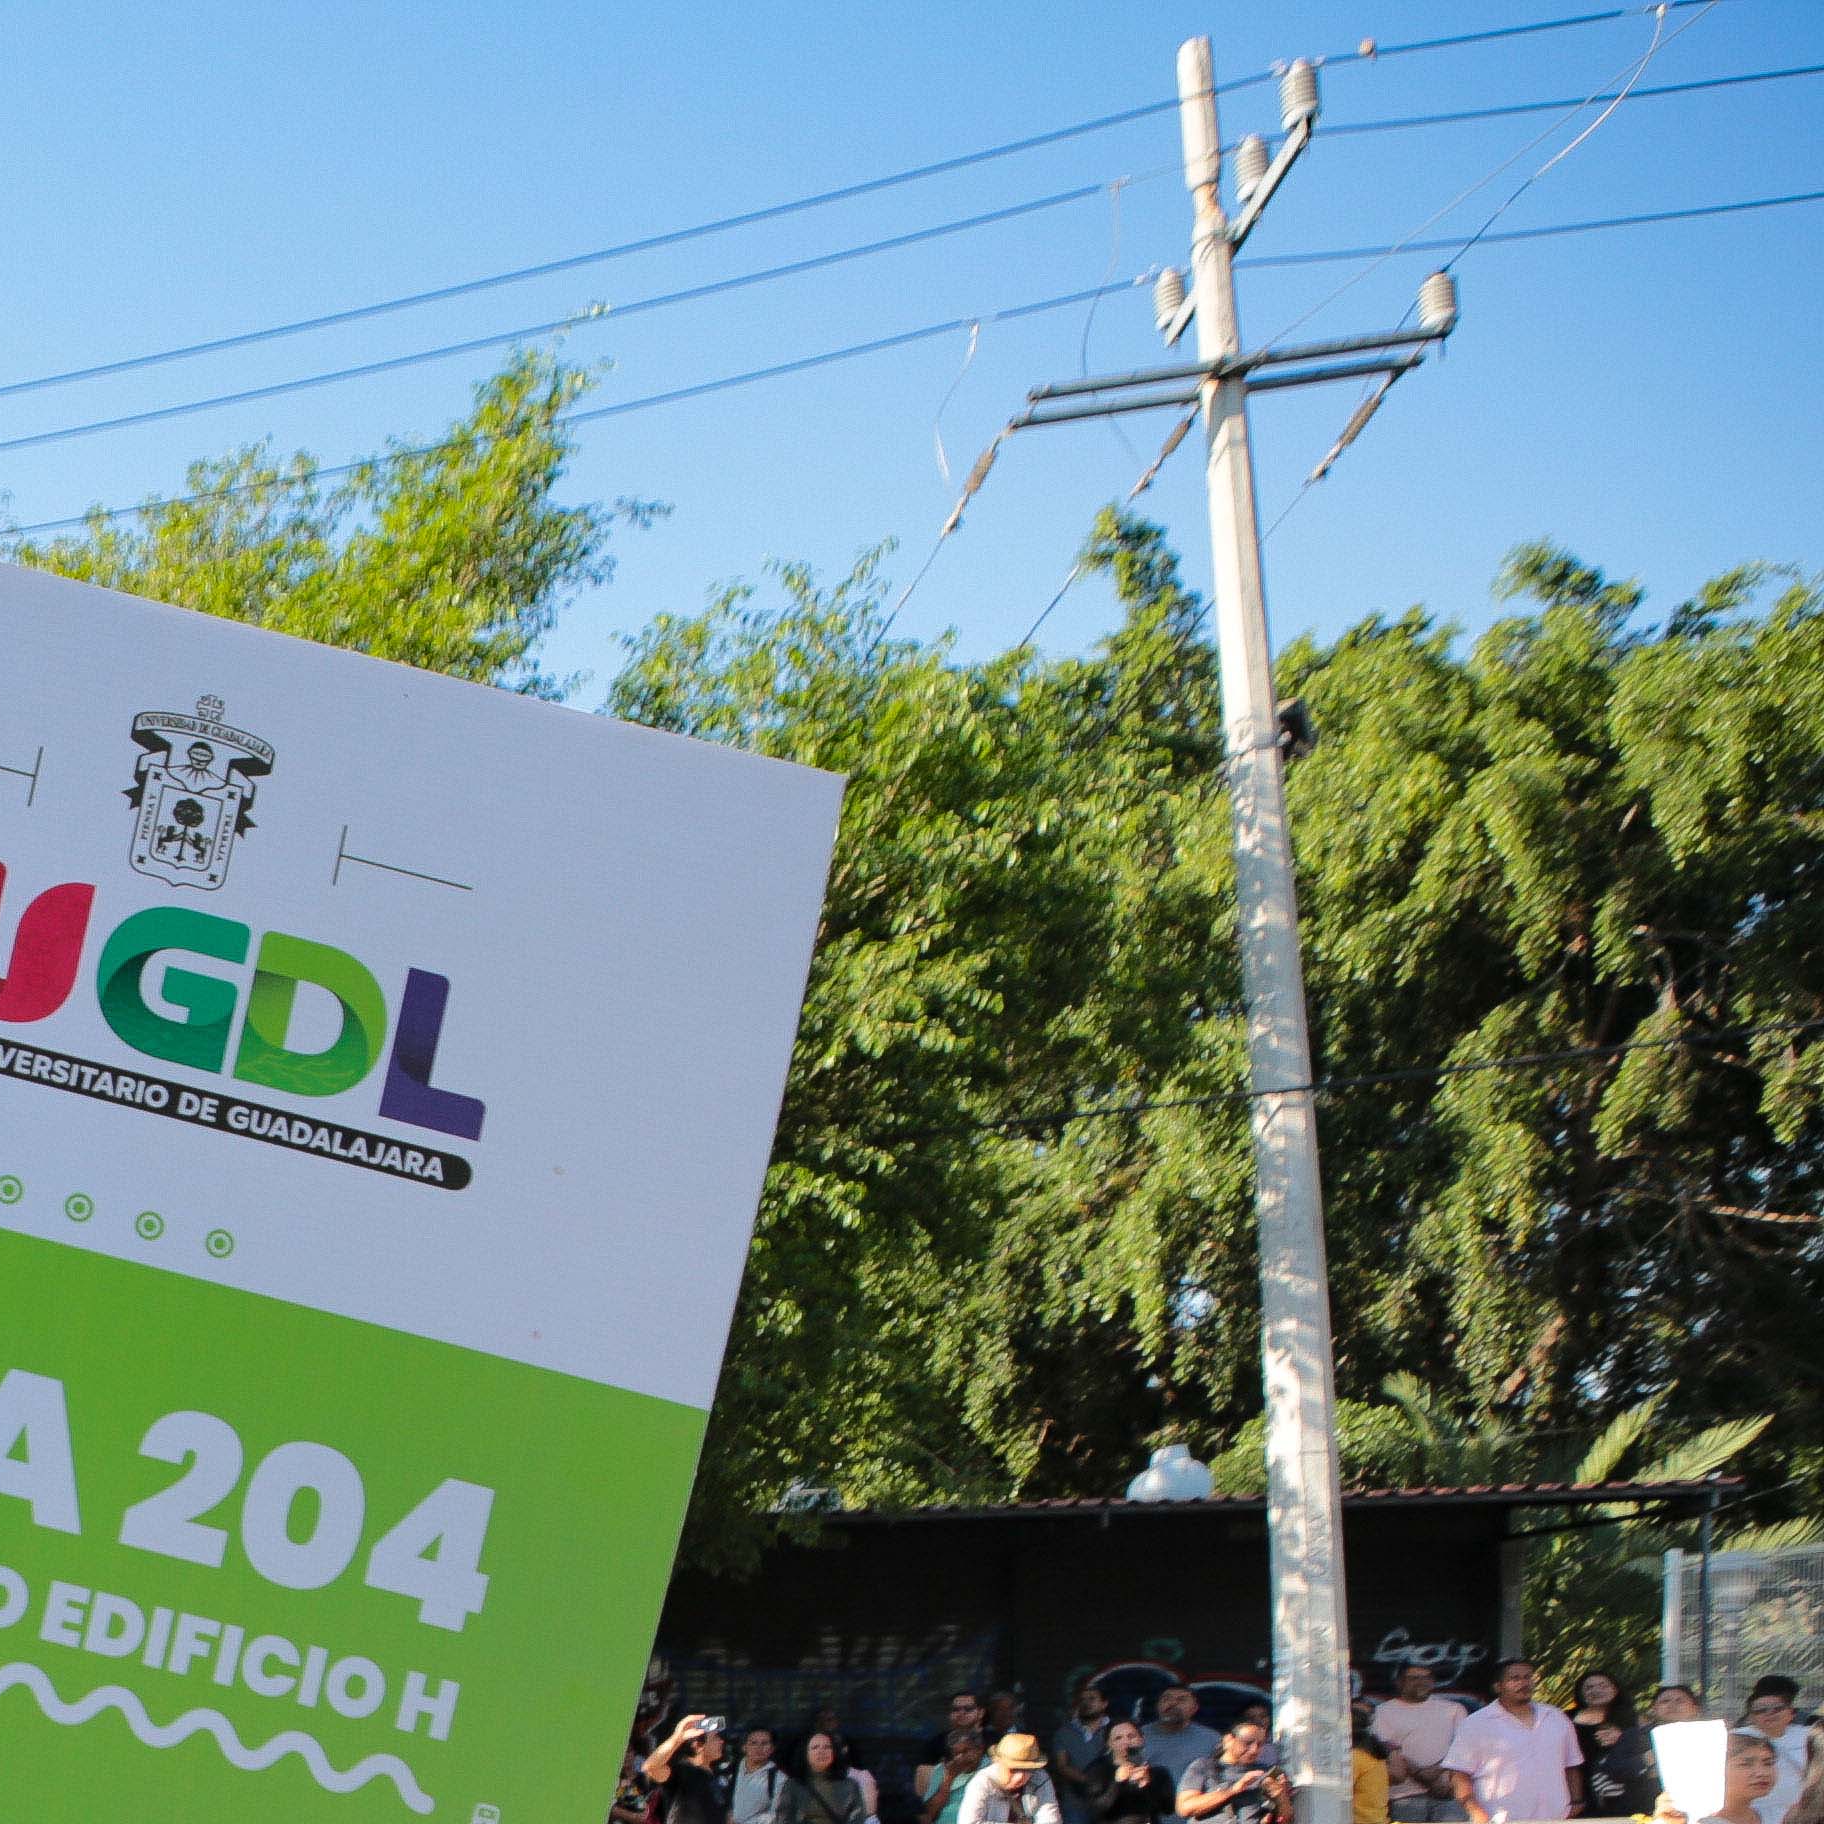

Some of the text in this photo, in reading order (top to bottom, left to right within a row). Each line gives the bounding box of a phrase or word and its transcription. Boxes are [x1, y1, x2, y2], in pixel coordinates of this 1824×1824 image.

[176, 1091, 220, 1123] DE
[226, 1105, 444, 1182] GUADALAJARA
[118, 1410, 498, 1632] 204
[39, 1581, 387, 1721] EDIFICIO
[394, 1676, 461, 1741] H
